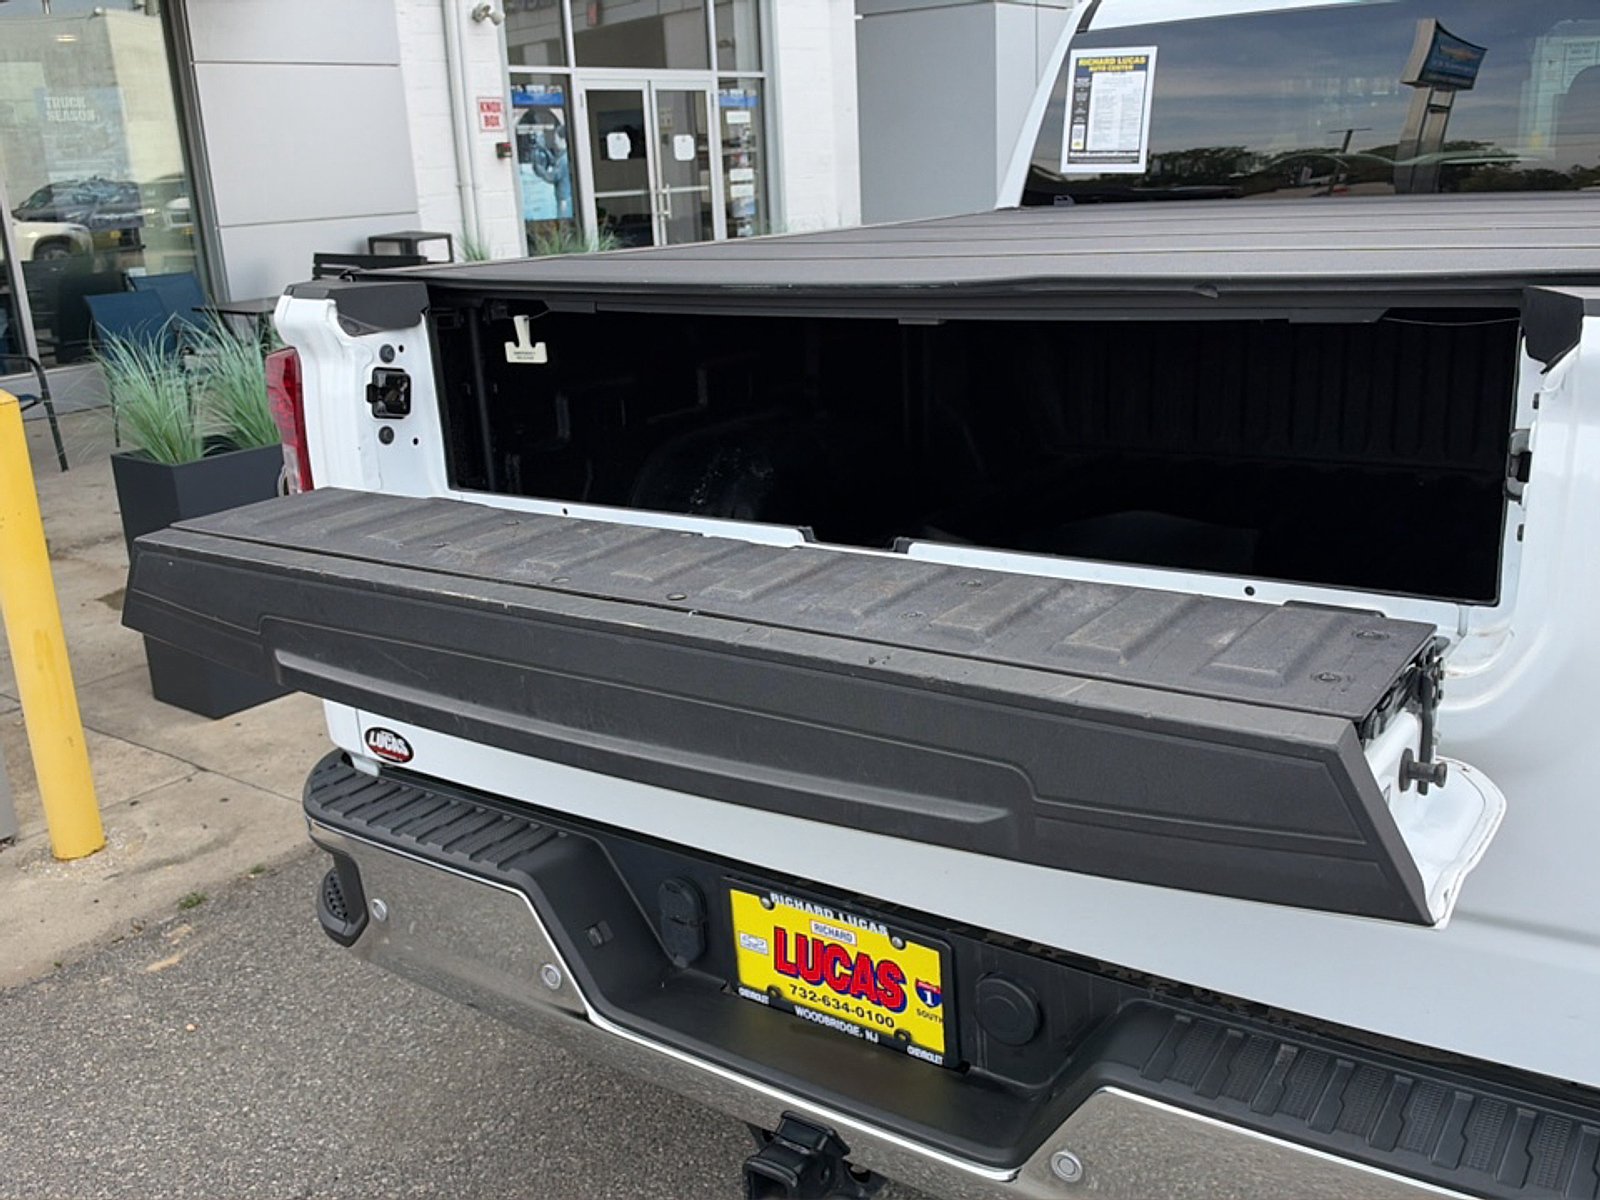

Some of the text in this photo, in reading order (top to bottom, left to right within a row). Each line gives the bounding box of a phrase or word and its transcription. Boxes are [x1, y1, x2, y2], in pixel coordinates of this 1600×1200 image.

[1079, 56, 1147, 67] RICHARD LUCAS
[44, 96, 86, 109] TRUCK
[484, 114, 501, 127] BOX
[769, 892, 889, 936] RICHARD LUCAS
[813, 922, 854, 943] RICHARD
[773, 926, 908, 1013] LUCAS
[789, 983, 896, 1029] 732-634-0100
[864, 1029, 880, 1043] NJ
